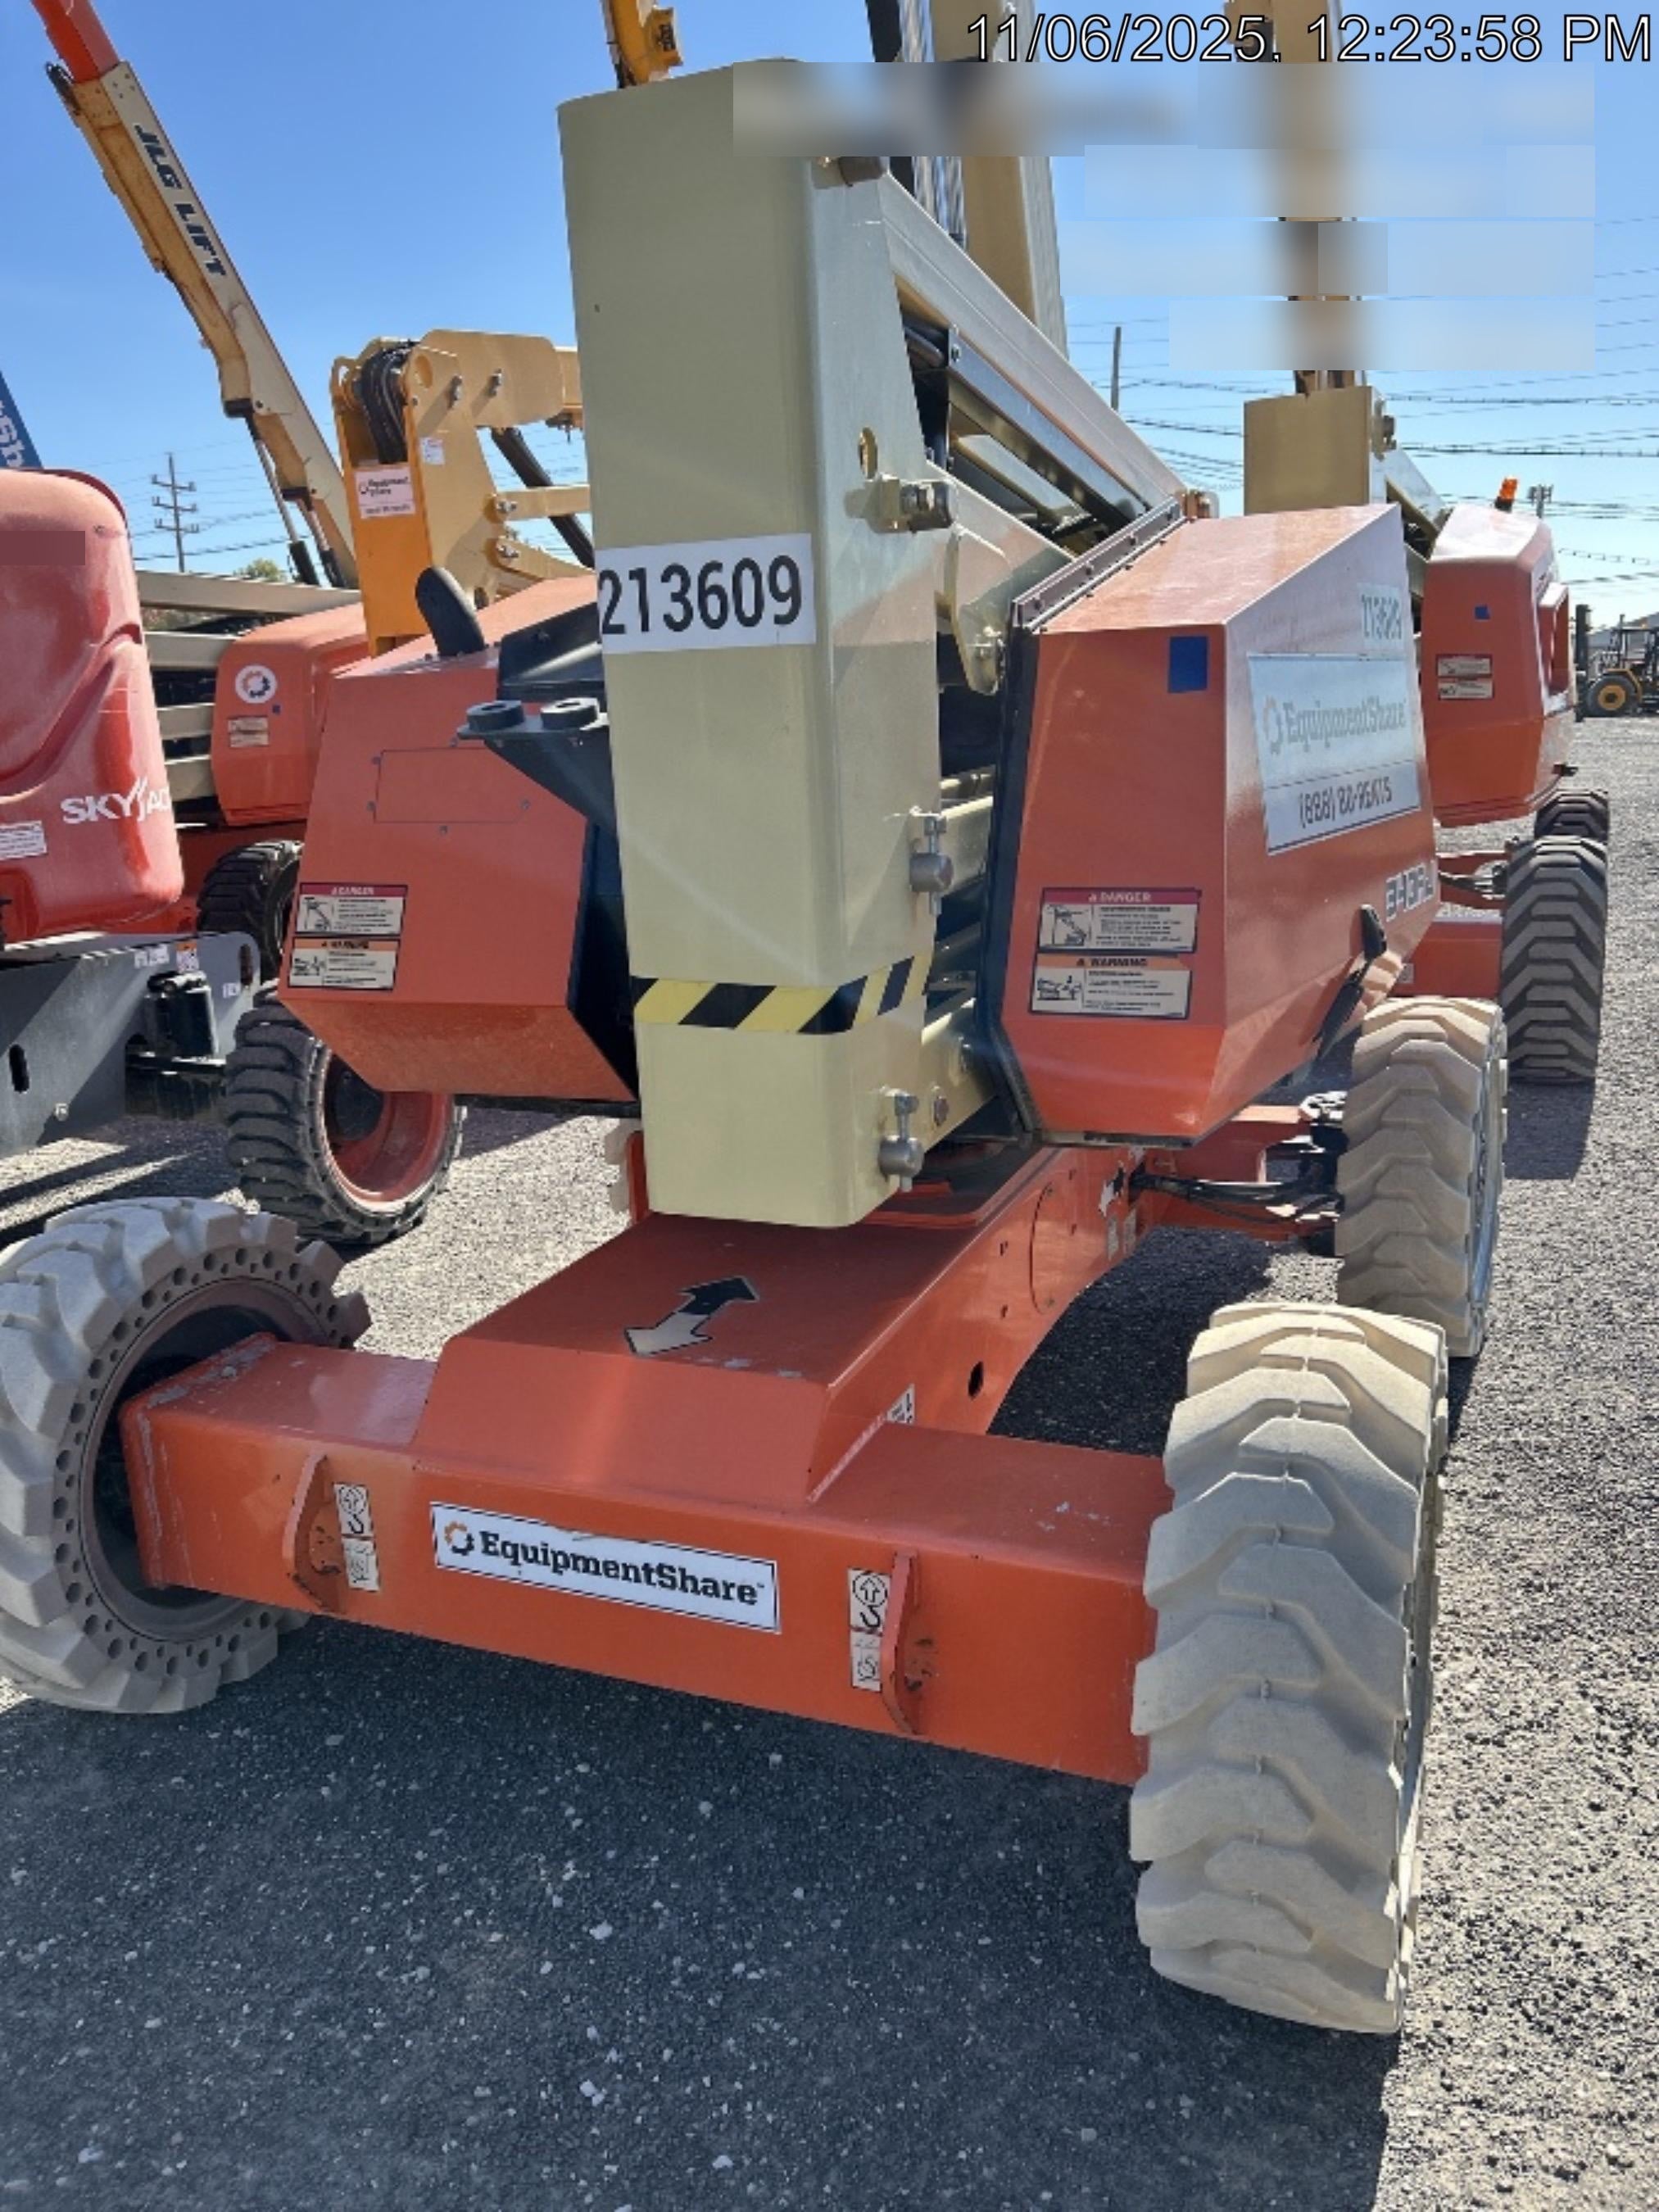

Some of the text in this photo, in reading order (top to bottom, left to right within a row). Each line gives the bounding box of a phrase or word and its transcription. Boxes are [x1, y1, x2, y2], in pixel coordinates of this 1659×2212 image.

[134, 125, 226, 275] JLG LIFT
[599, 555, 802, 635] 213609
[1100, 891, 1152, 902] DANGER
[1091, 958, 1147, 967] WARNING
[479, 1530, 759, 1606] EquipmentShare
